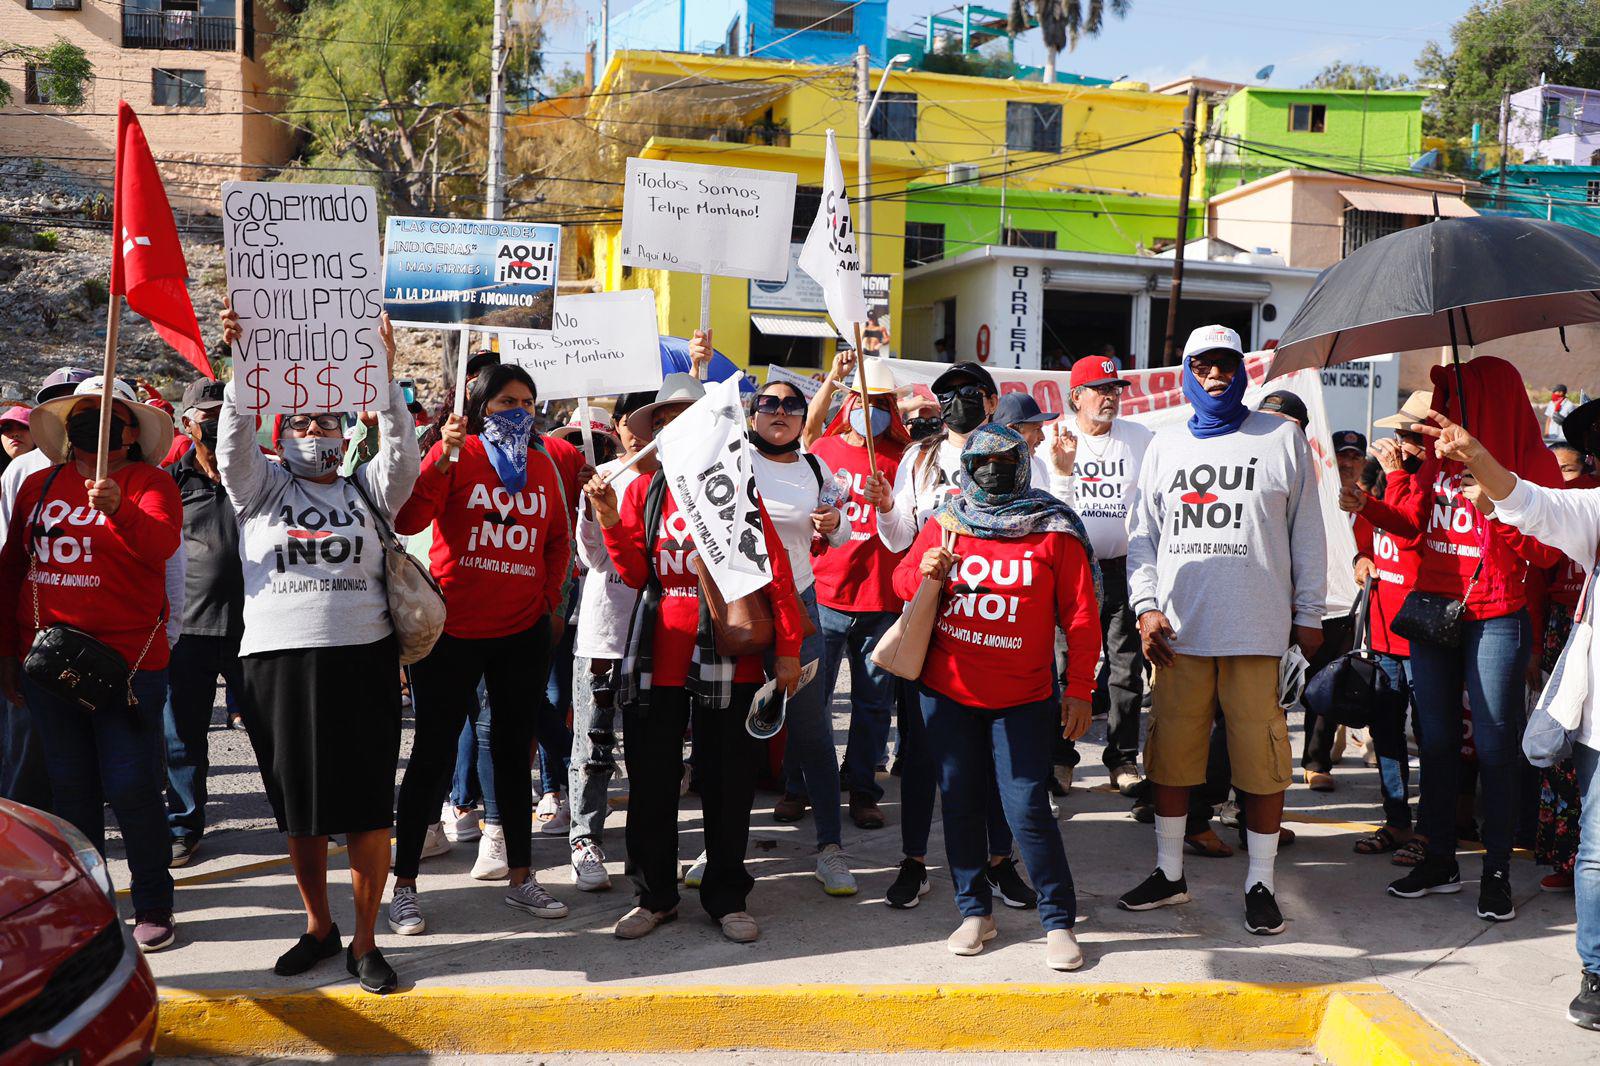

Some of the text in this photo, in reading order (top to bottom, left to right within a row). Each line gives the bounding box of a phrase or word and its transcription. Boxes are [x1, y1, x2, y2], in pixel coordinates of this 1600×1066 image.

[699, 179, 760, 200] Somos
[430, 222, 536, 238] COMUNIDADES
[498, 243, 554, 262] AQUÍ
[406, 261, 432, 272] MAS
[435, 263, 480, 275] FIRMES
[500, 264, 548, 281] ¡NO!
[422, 288, 459, 302] PLANTA
[462, 290, 476, 302] DE
[1010, 266, 1029, 369] BIRRIERI
[509, 335, 600, 351] Todos Somos
[1340, 373, 1382, 388] CHENCO
[1168, 457, 1258, 498] AQUÍ
[467, 483, 547, 521] AQUÍ
[278, 500, 366, 530] AQUÍ
[1174, 502, 1243, 536] ¡NO!
[467, 521, 537, 553] ¡NO!
[274, 536, 364, 573] ¡NO!
[1169, 543, 1248, 556] A LA PLANTA DE AMONIACO
[475, 557, 500, 572] PLANTA
[501, 562, 510, 574] DE
[61, 574, 100, 587] AMONIACO
[272, 578, 368, 594] A LA PLANTA DE AMONIACO
[972, 633, 982, 645] DE
[983, 634, 1022, 649] AMONIACO
